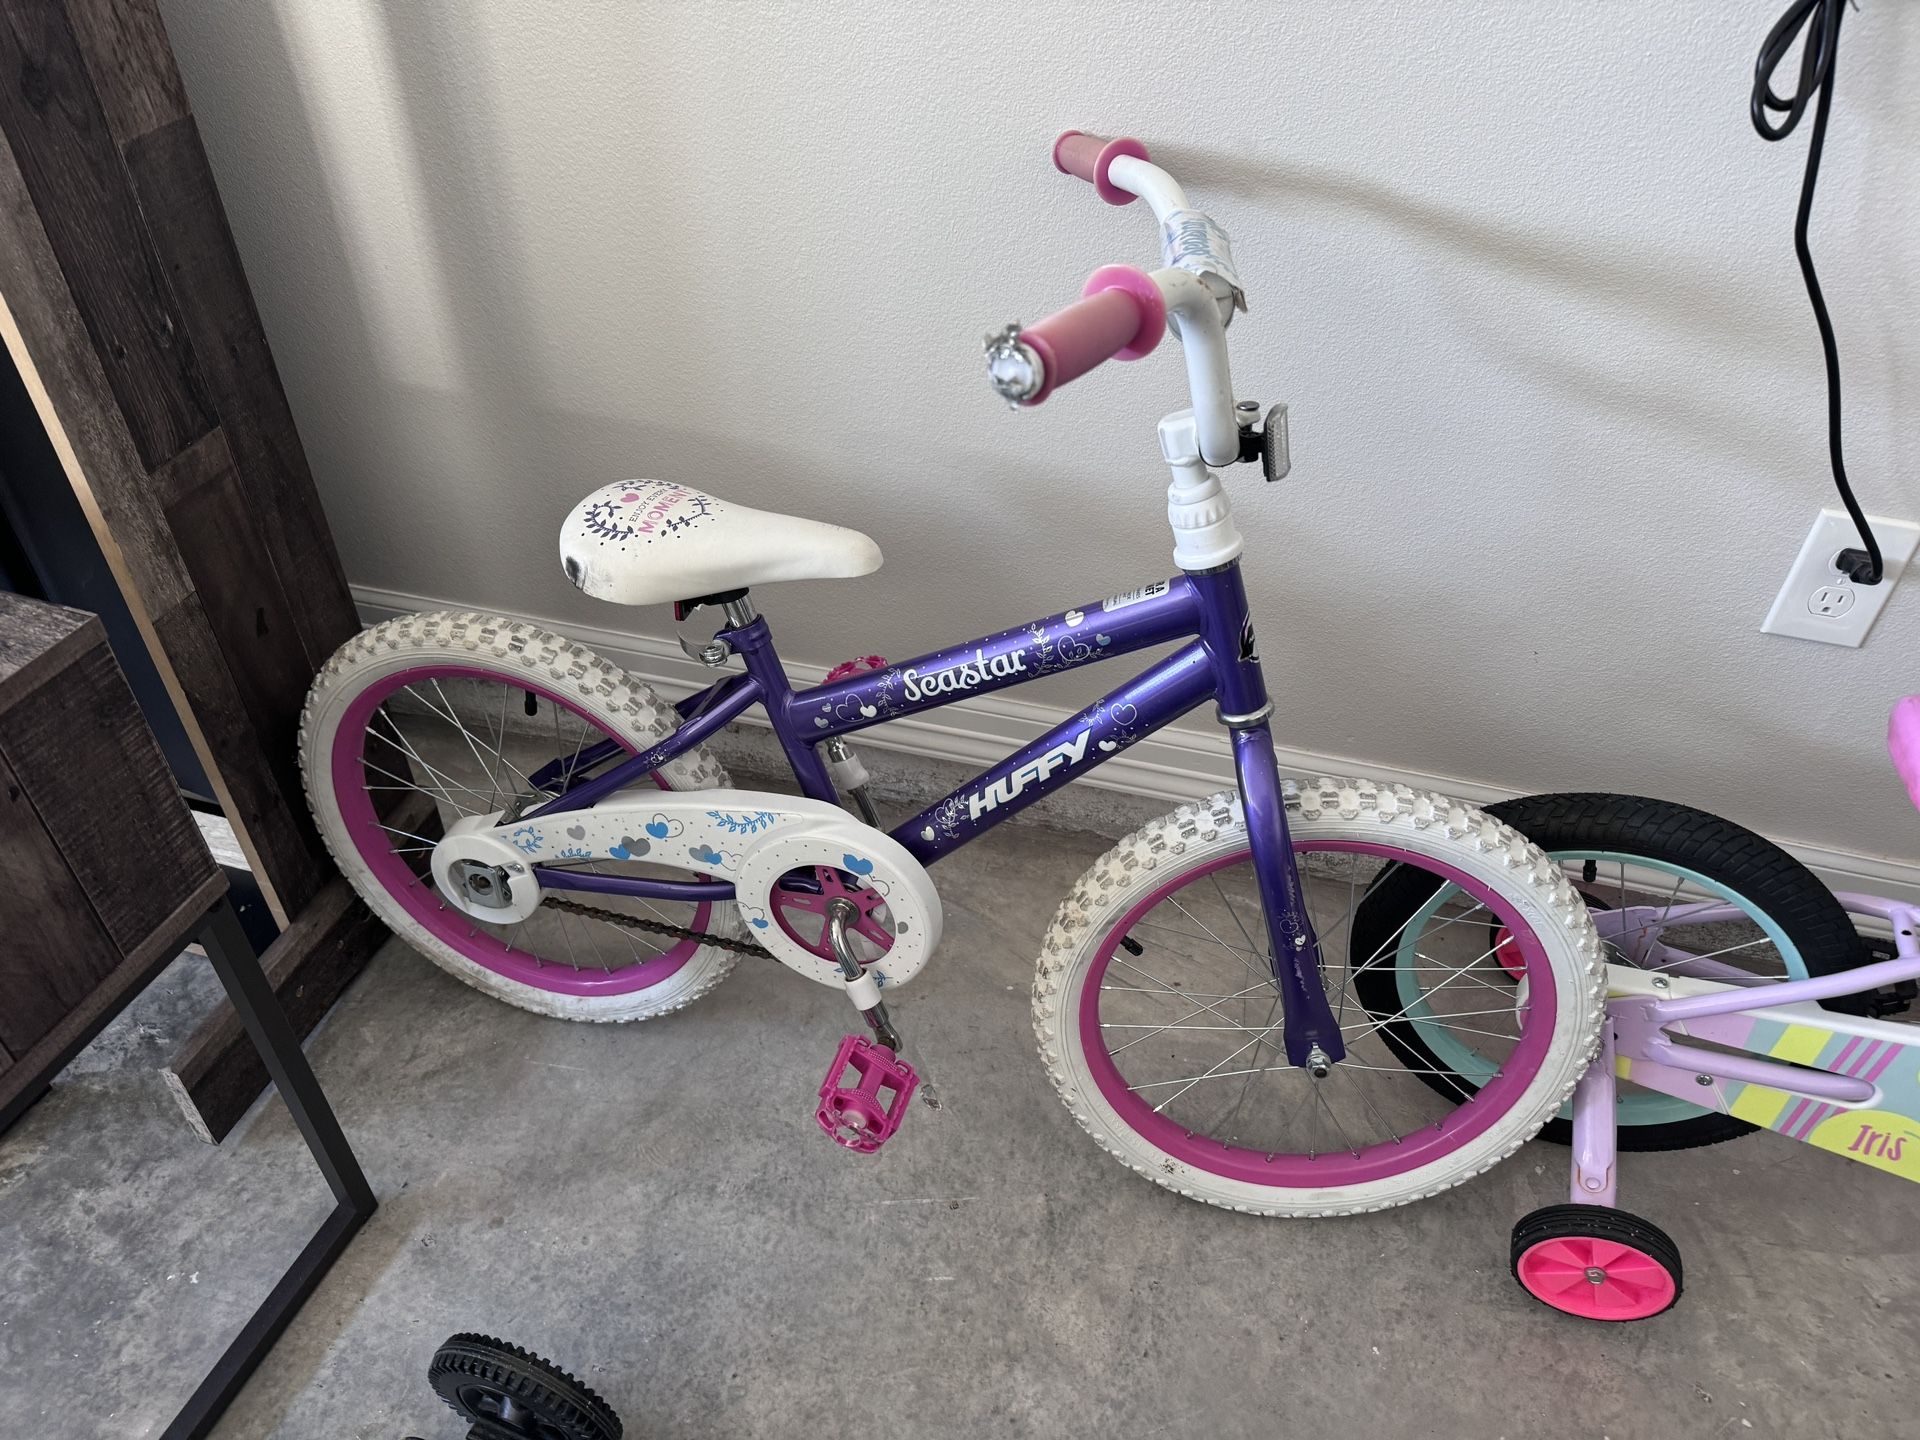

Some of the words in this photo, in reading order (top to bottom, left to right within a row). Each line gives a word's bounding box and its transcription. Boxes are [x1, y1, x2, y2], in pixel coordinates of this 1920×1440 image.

[628, 500, 650, 523] ENJOY
[637, 489, 692, 533] MOMENT
[903, 648, 1027, 701] Seastar
[969, 728, 1091, 820] HUFFY
[1847, 1124, 1908, 1161] Iris
